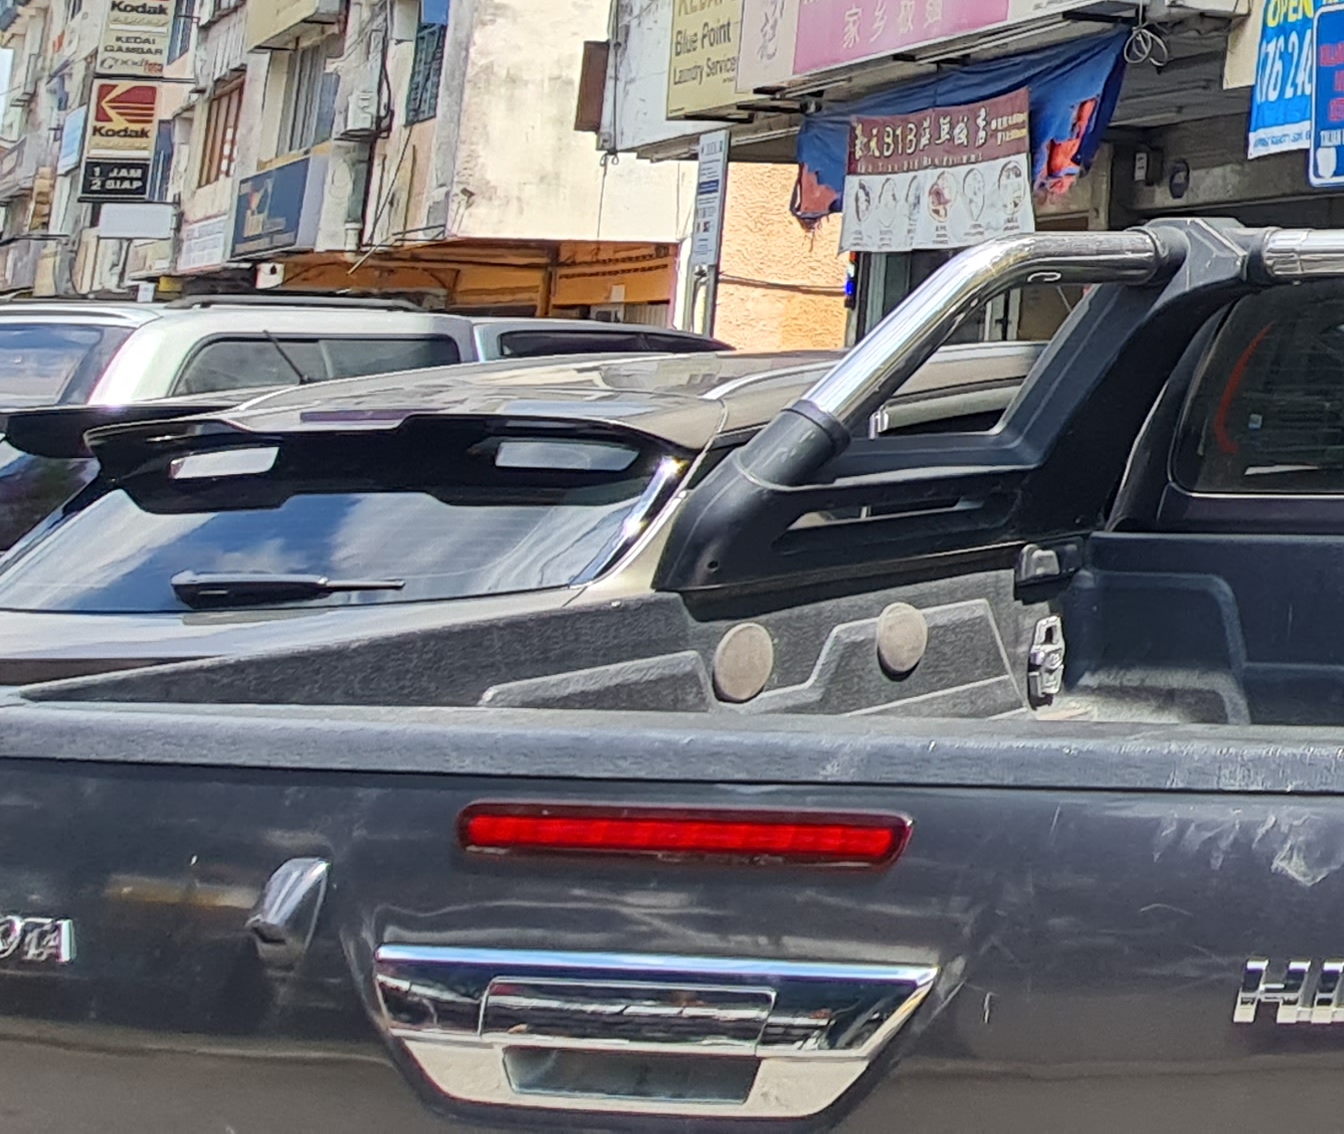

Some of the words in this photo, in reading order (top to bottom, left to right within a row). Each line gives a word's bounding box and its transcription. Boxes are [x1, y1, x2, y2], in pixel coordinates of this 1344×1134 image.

[110, 0, 169, 16] Kodak
[114, 35, 157, 46] KEDAI
[674, 29, 698, 57] Blue
[701, 18, 731, 49] Point
[706, 54, 738, 78] Service
[92, 124, 150, 139] Kodak
[108, 168, 143, 180] JAM
